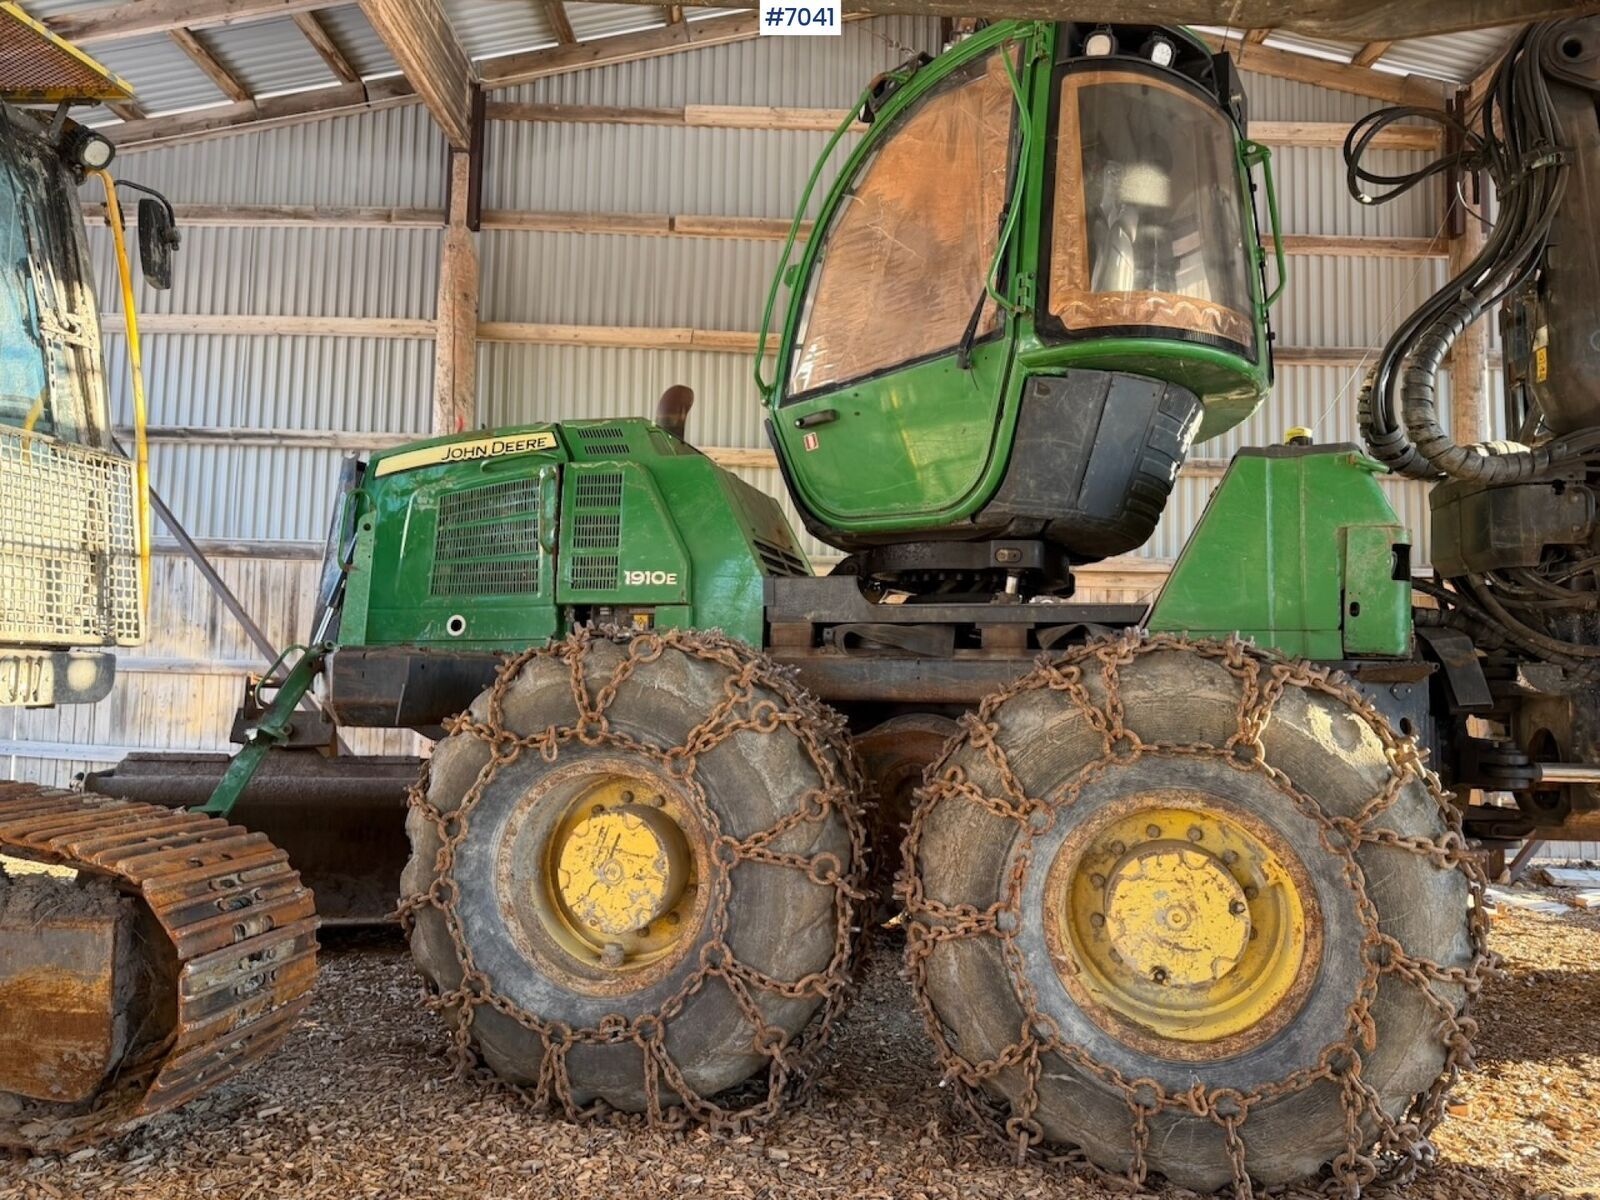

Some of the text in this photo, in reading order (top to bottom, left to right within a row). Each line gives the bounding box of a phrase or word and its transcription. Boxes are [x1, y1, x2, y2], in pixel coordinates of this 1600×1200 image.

[441, 436, 548, 461] JOHN DEERE
[623, 569, 678, 585] 1910E
